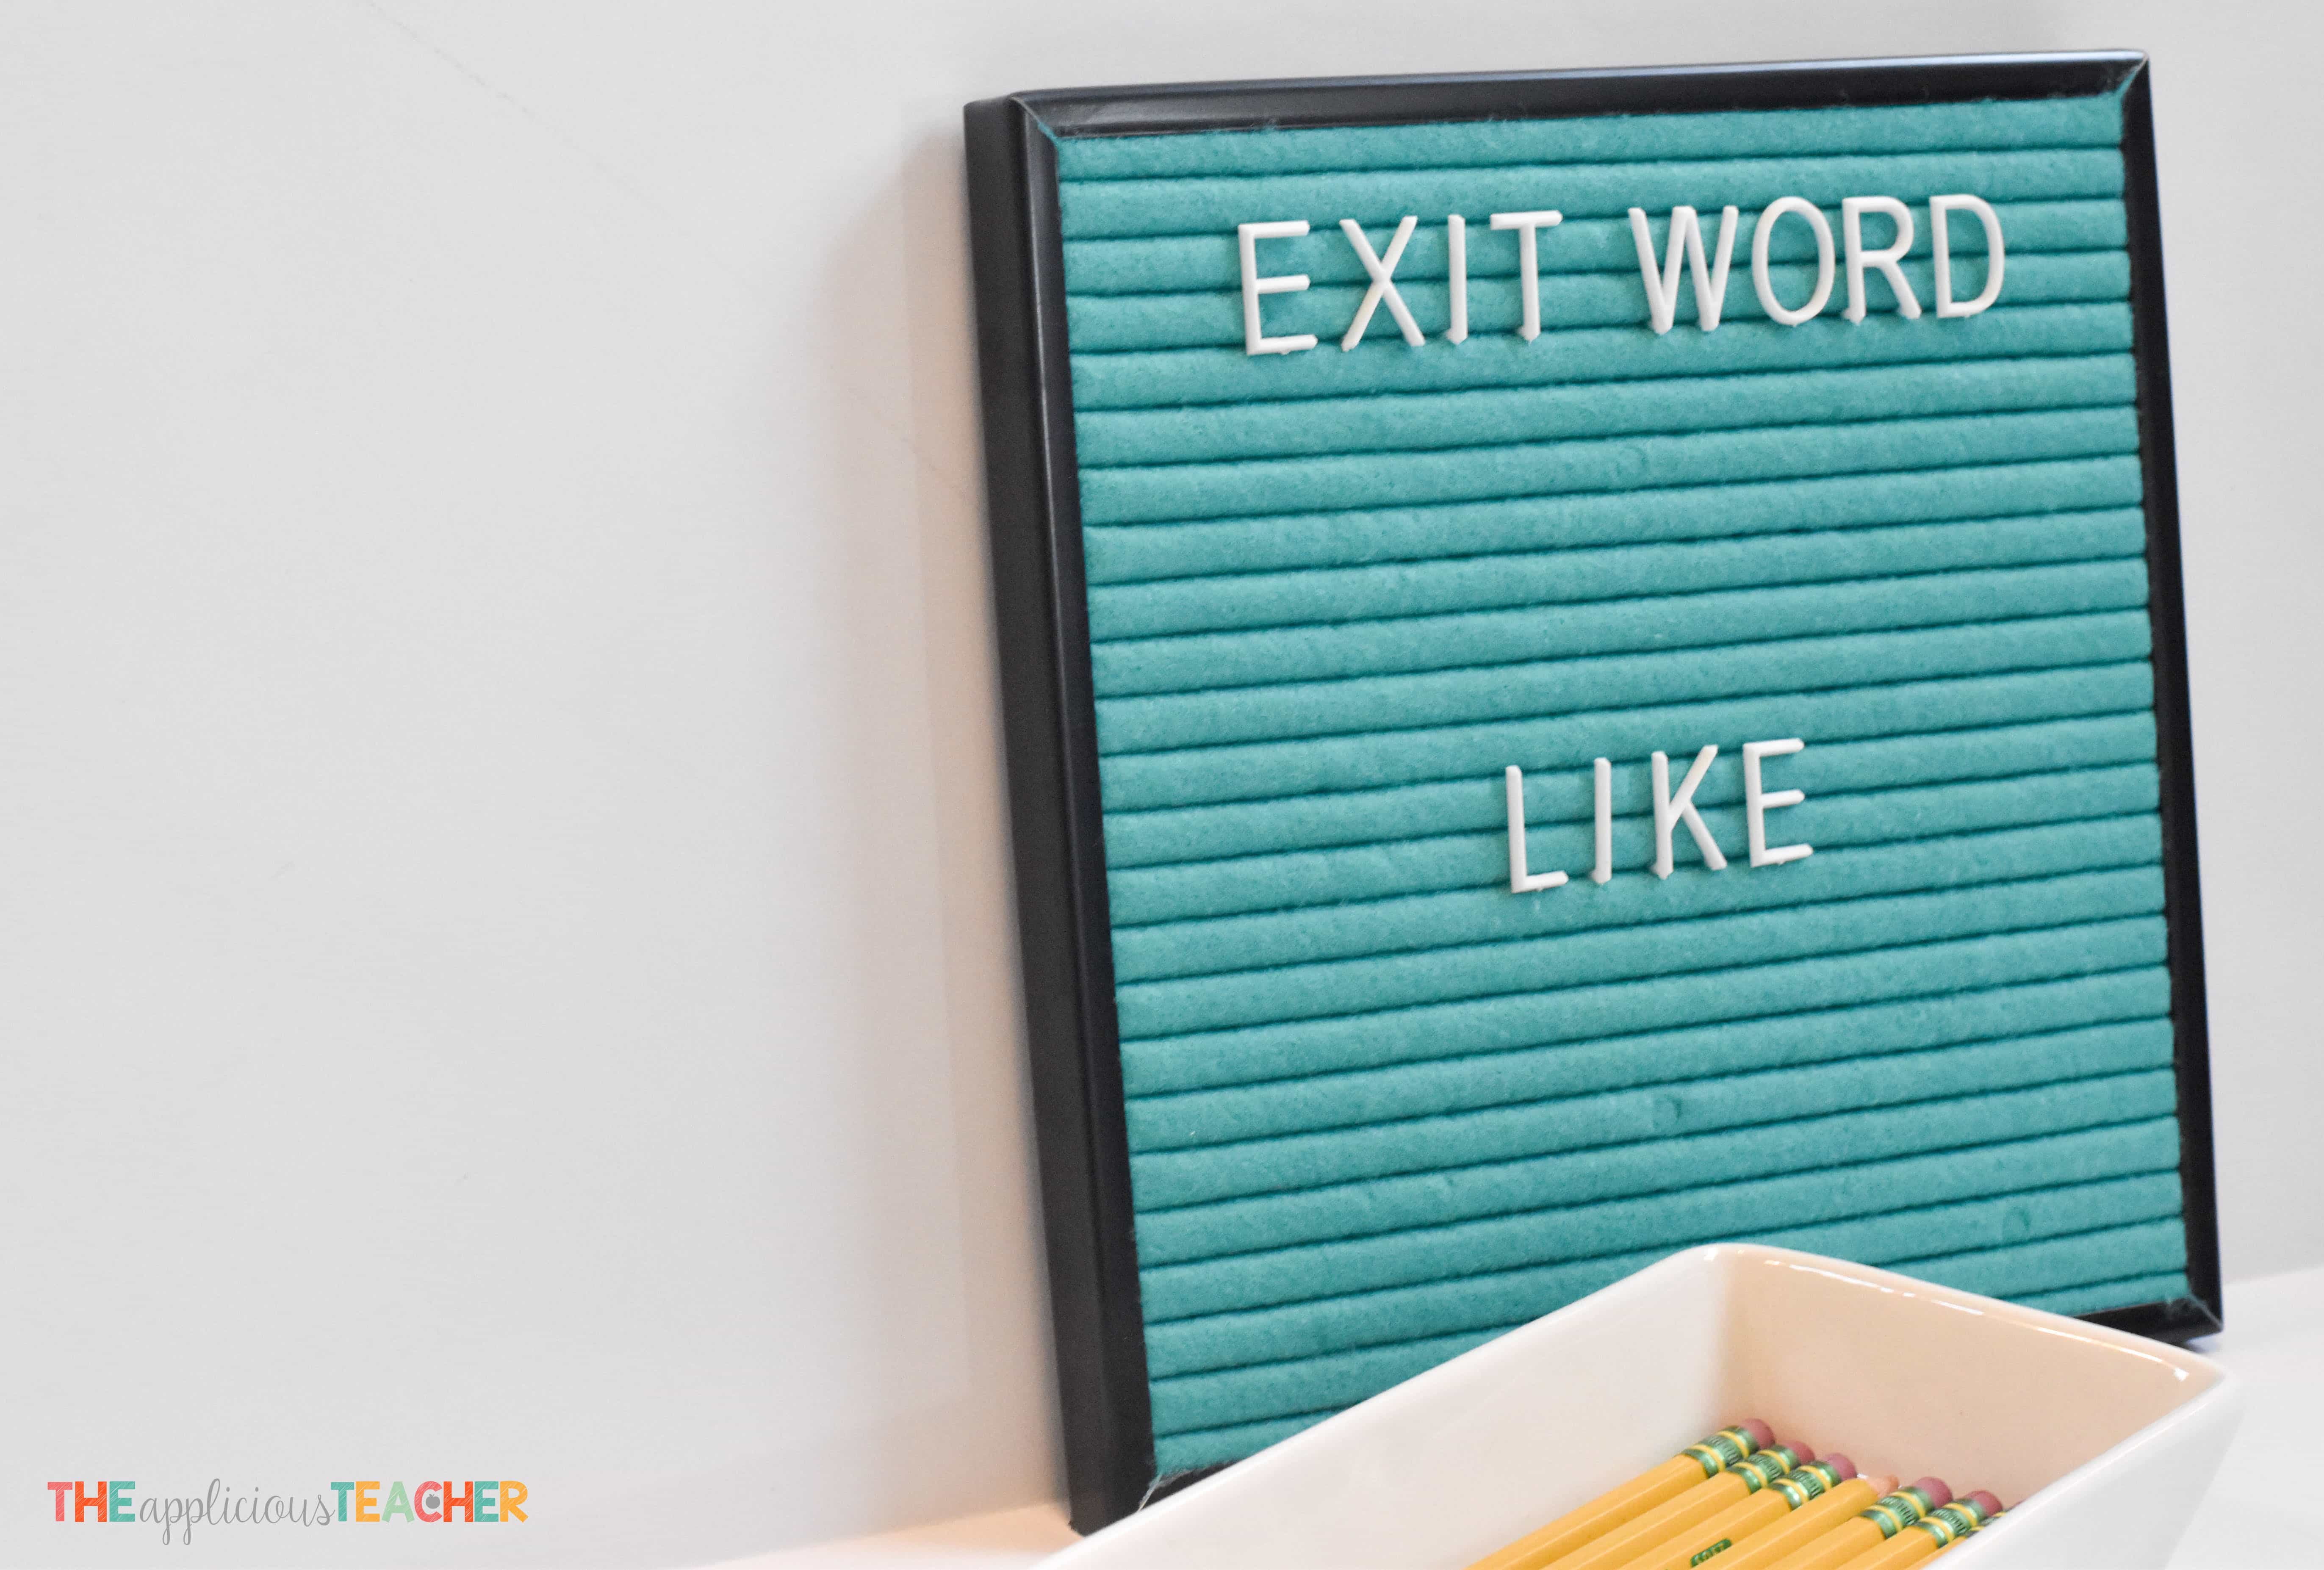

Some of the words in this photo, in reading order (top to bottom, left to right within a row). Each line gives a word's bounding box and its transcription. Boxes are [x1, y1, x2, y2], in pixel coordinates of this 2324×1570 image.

[1238, 211, 1562, 355] EXIT
[1629, 194, 2005, 334] WORD
[1506, 738, 1813, 893] LIKE
